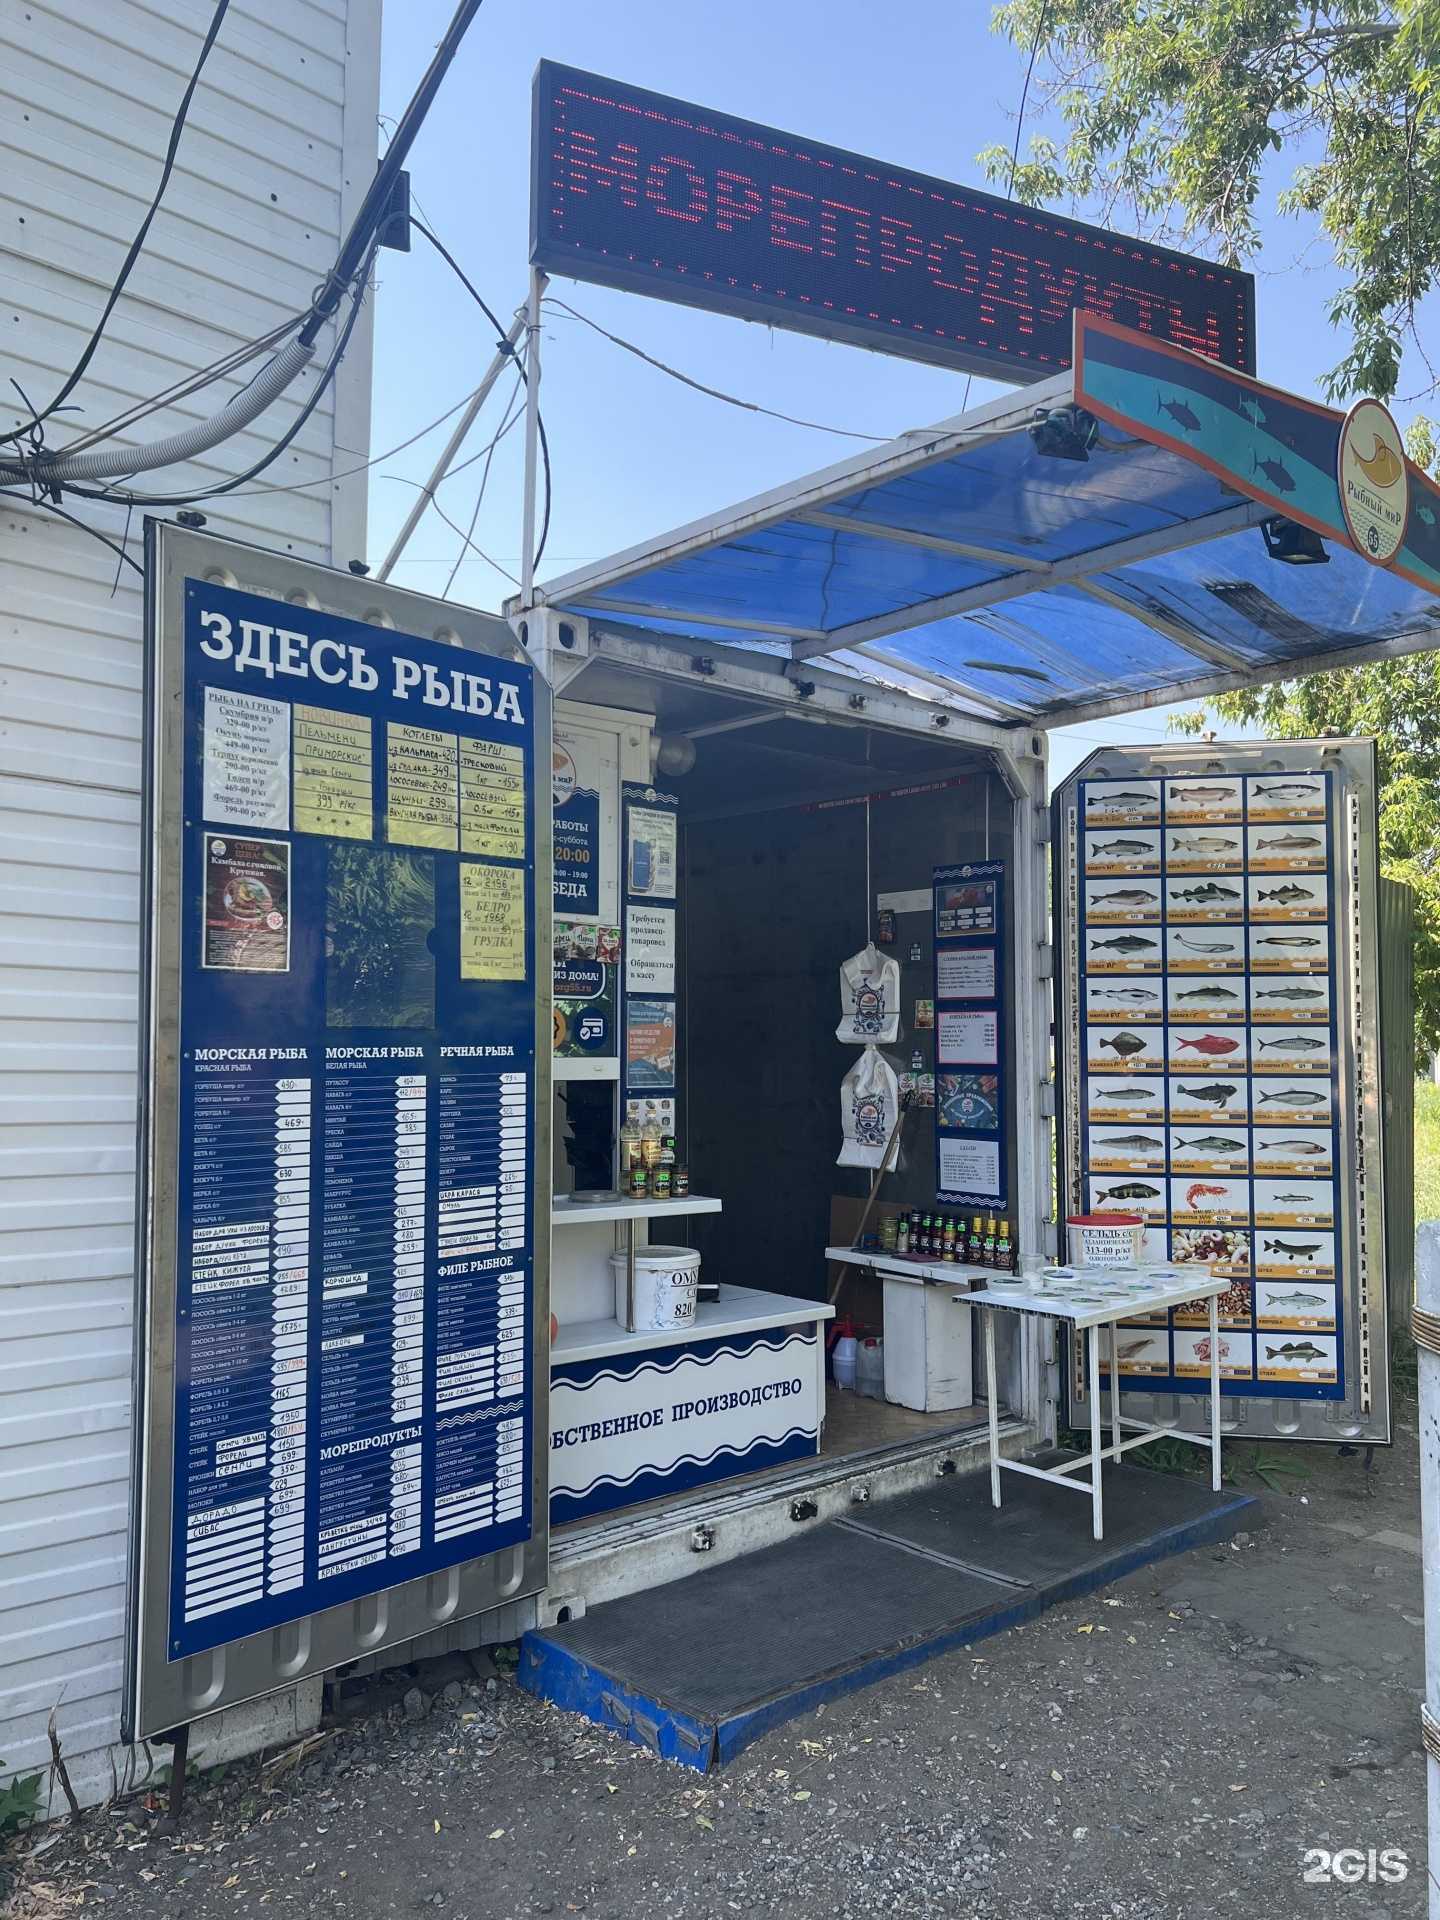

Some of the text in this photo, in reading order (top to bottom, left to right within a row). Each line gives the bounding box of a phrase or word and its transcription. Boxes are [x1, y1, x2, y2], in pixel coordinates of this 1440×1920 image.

[569, 131, 1222, 360] МОРЕПРОДУКТЫ
[1347, 479, 1384, 515] Рыбный
[200, 610, 525, 725] ЗДЕСЬ РЫБА
[555, 846, 590, 864] 20:00
[631, 913, 666, 928] Требуется
[630, 957, 674, 970] Обращаться
[568, 971, 600, 981] ДОМА!
[636, 971, 656, 982] кассу
[195, 1048, 308, 1060] МОРСКАЯ РЫБА
[325, 1047, 424, 1059] МОРСКАЯ РЫБА
[440, 1046, 514, 1057] РЕЧНАЯ РЫБА
[194, 1064, 230, 1072] КРАСНАЯ
[1081, 1229, 1122, 1239] СЕЛЬДЬ
[438, 1256, 514, 1277] ФИЛЕ РЫБНОЕ
[550, 1378, 802, 1450] БСТВЕННОЕ ПРОИЗВОДСТВО
[320, 1425, 423, 1461] МОРЕПРОДУКТЫ
